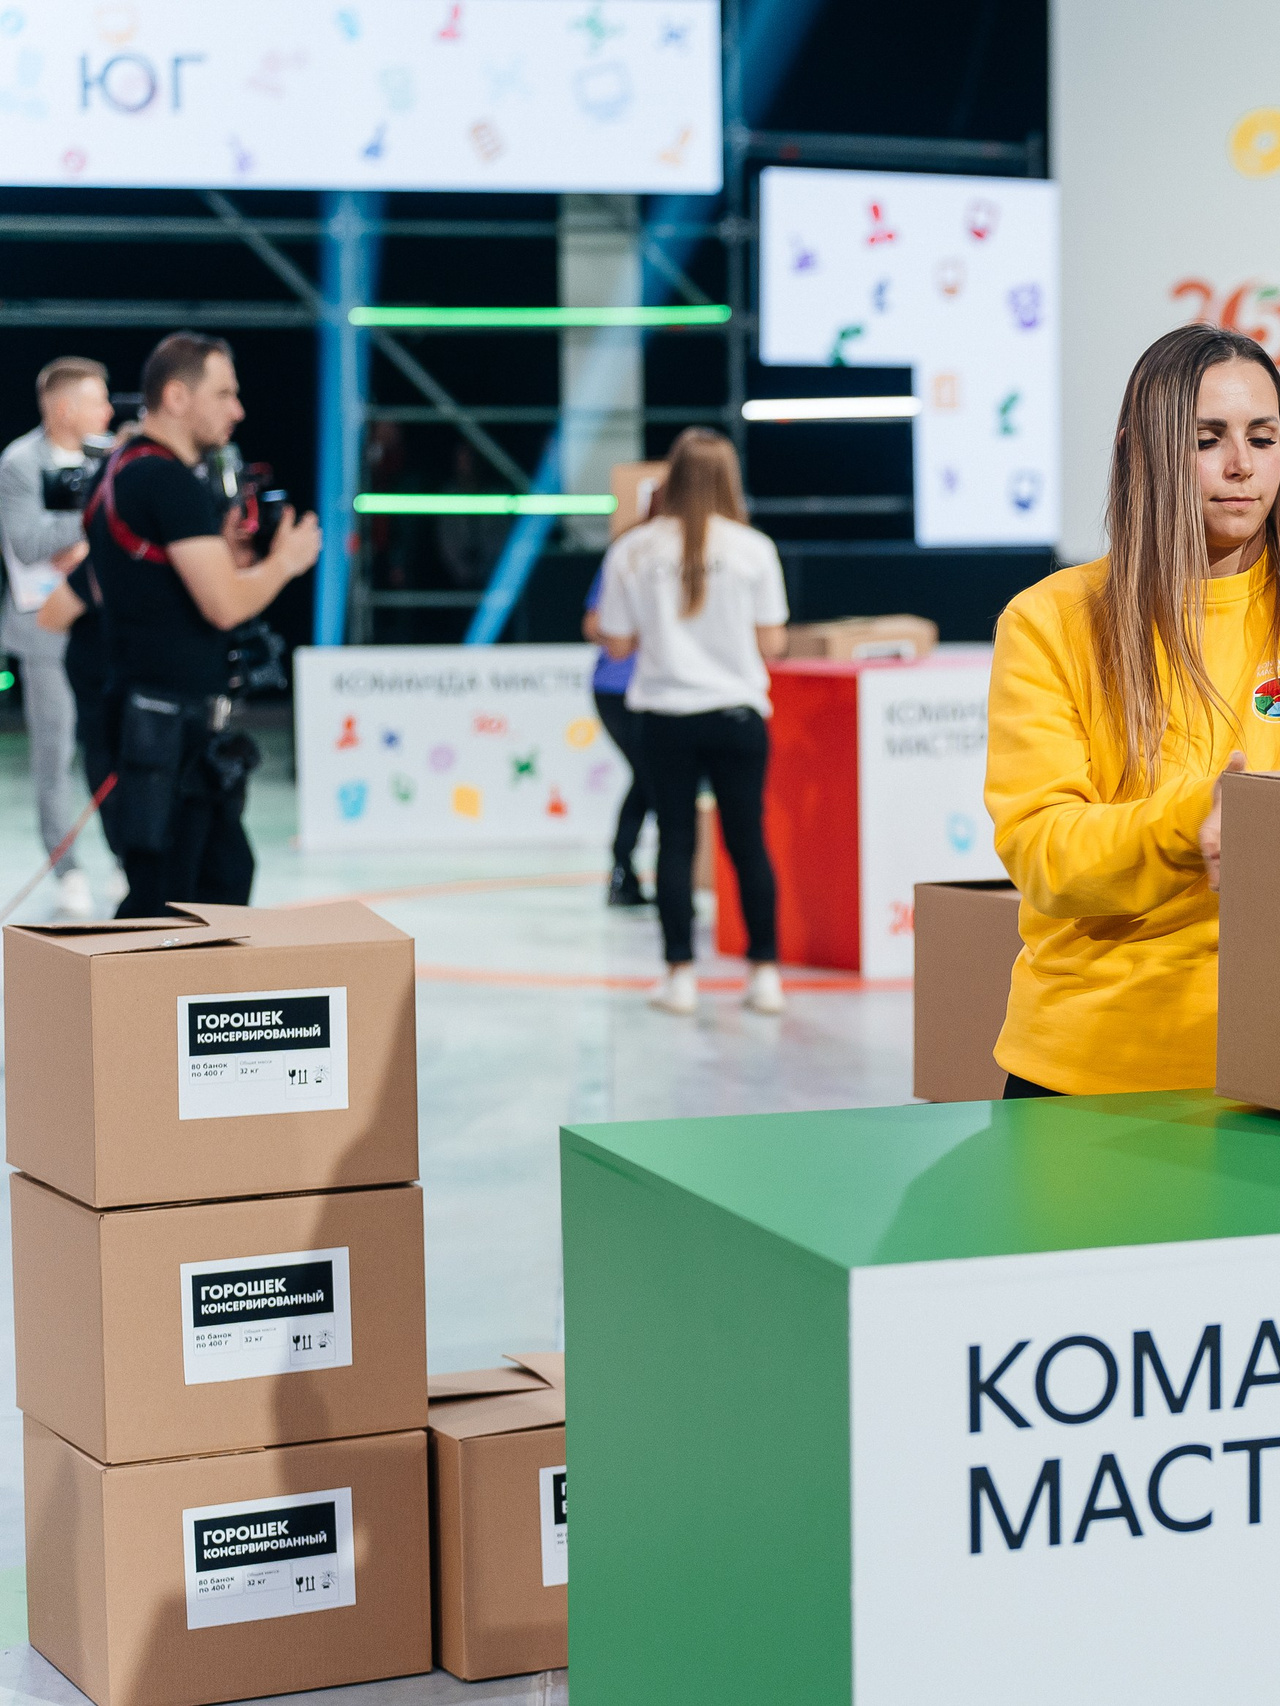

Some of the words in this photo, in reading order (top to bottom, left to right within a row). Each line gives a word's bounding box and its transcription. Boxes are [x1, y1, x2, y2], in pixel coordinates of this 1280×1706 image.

[79, 52, 206, 114] ЮГ
[197, 1010, 284, 1030] ГОРОШЕК
[197, 1024, 321, 1044] КОНСЕРВИРОВАННЫЙ
[200, 1277, 287, 1301] ГОРОШЕК
[201, 1289, 324, 1315] КОНСЕРВИРОВАННЫЙ
[203, 1519, 289, 1546] ГОРОШЕК
[203, 1530, 327, 1560] КОНСЕРВИРОВАННЫЙ
